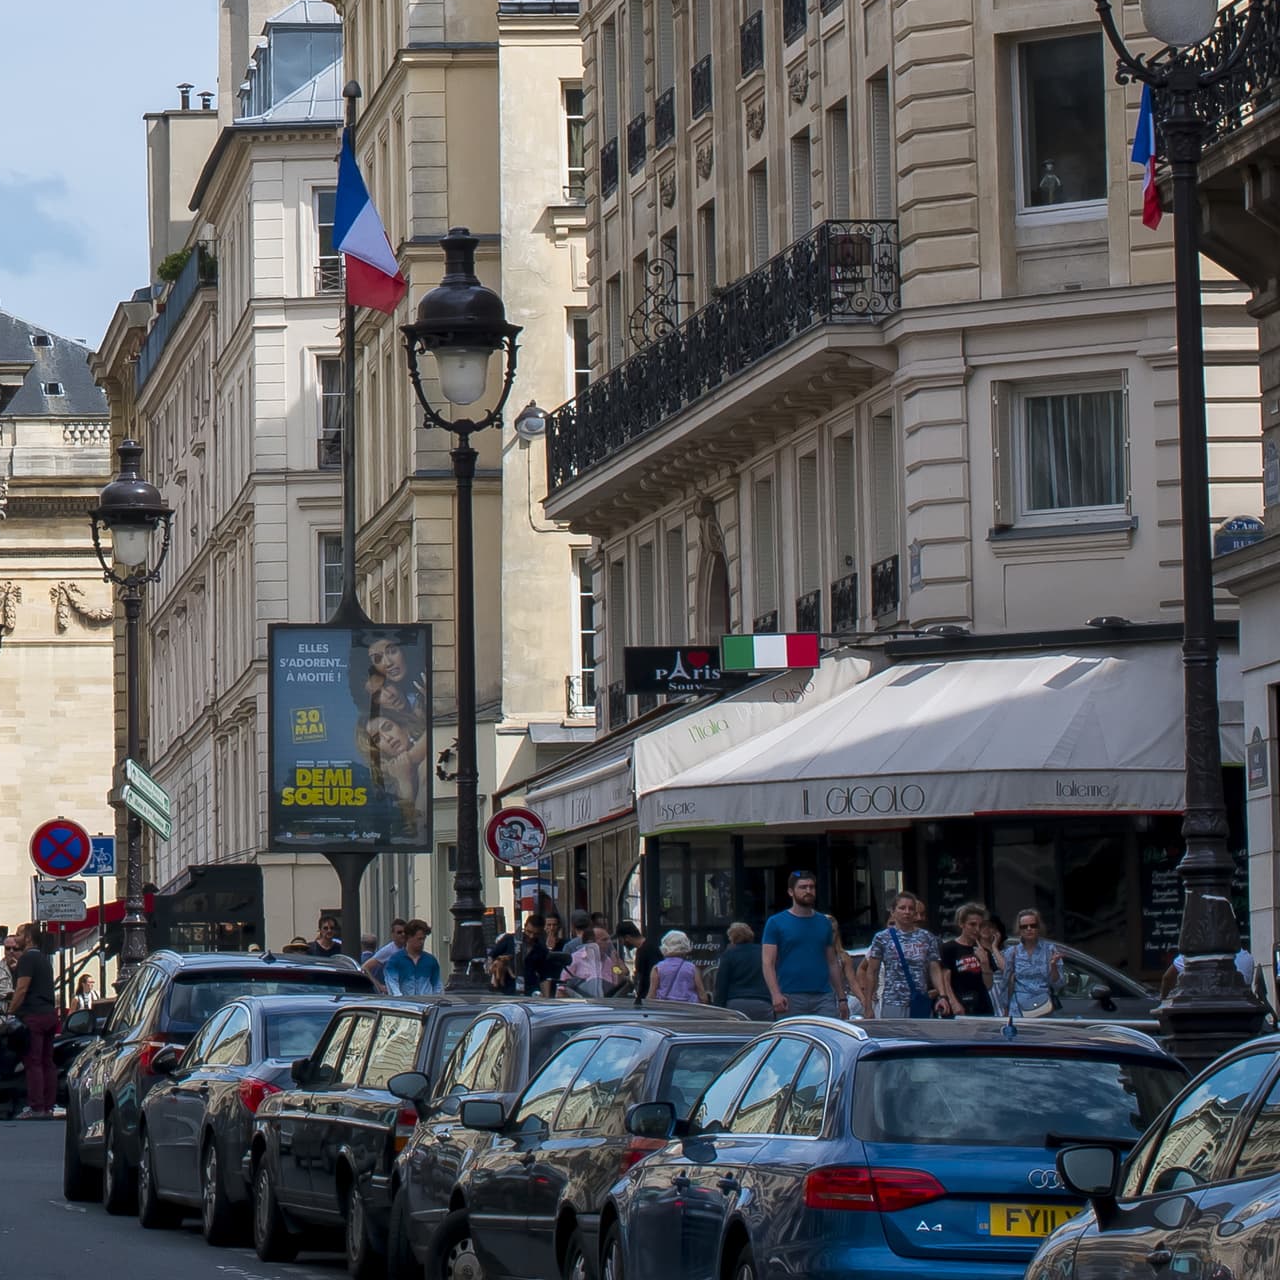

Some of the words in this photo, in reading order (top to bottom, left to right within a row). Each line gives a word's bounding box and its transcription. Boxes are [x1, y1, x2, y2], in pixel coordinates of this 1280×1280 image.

[298, 643, 329, 654] ELLES
[279, 658, 348, 668] S'ADORENT...
[286, 671, 295, 682] À
[296, 670, 335, 682] MOITIÉ
[296, 709, 320, 725] 30
[295, 722, 324, 735] MAI
[295, 768, 353, 787] DEMI
[802, 788, 813, 816] IL
[825, 783, 925, 816] GIGOLO
[916, 1220, 942, 1232] A4
